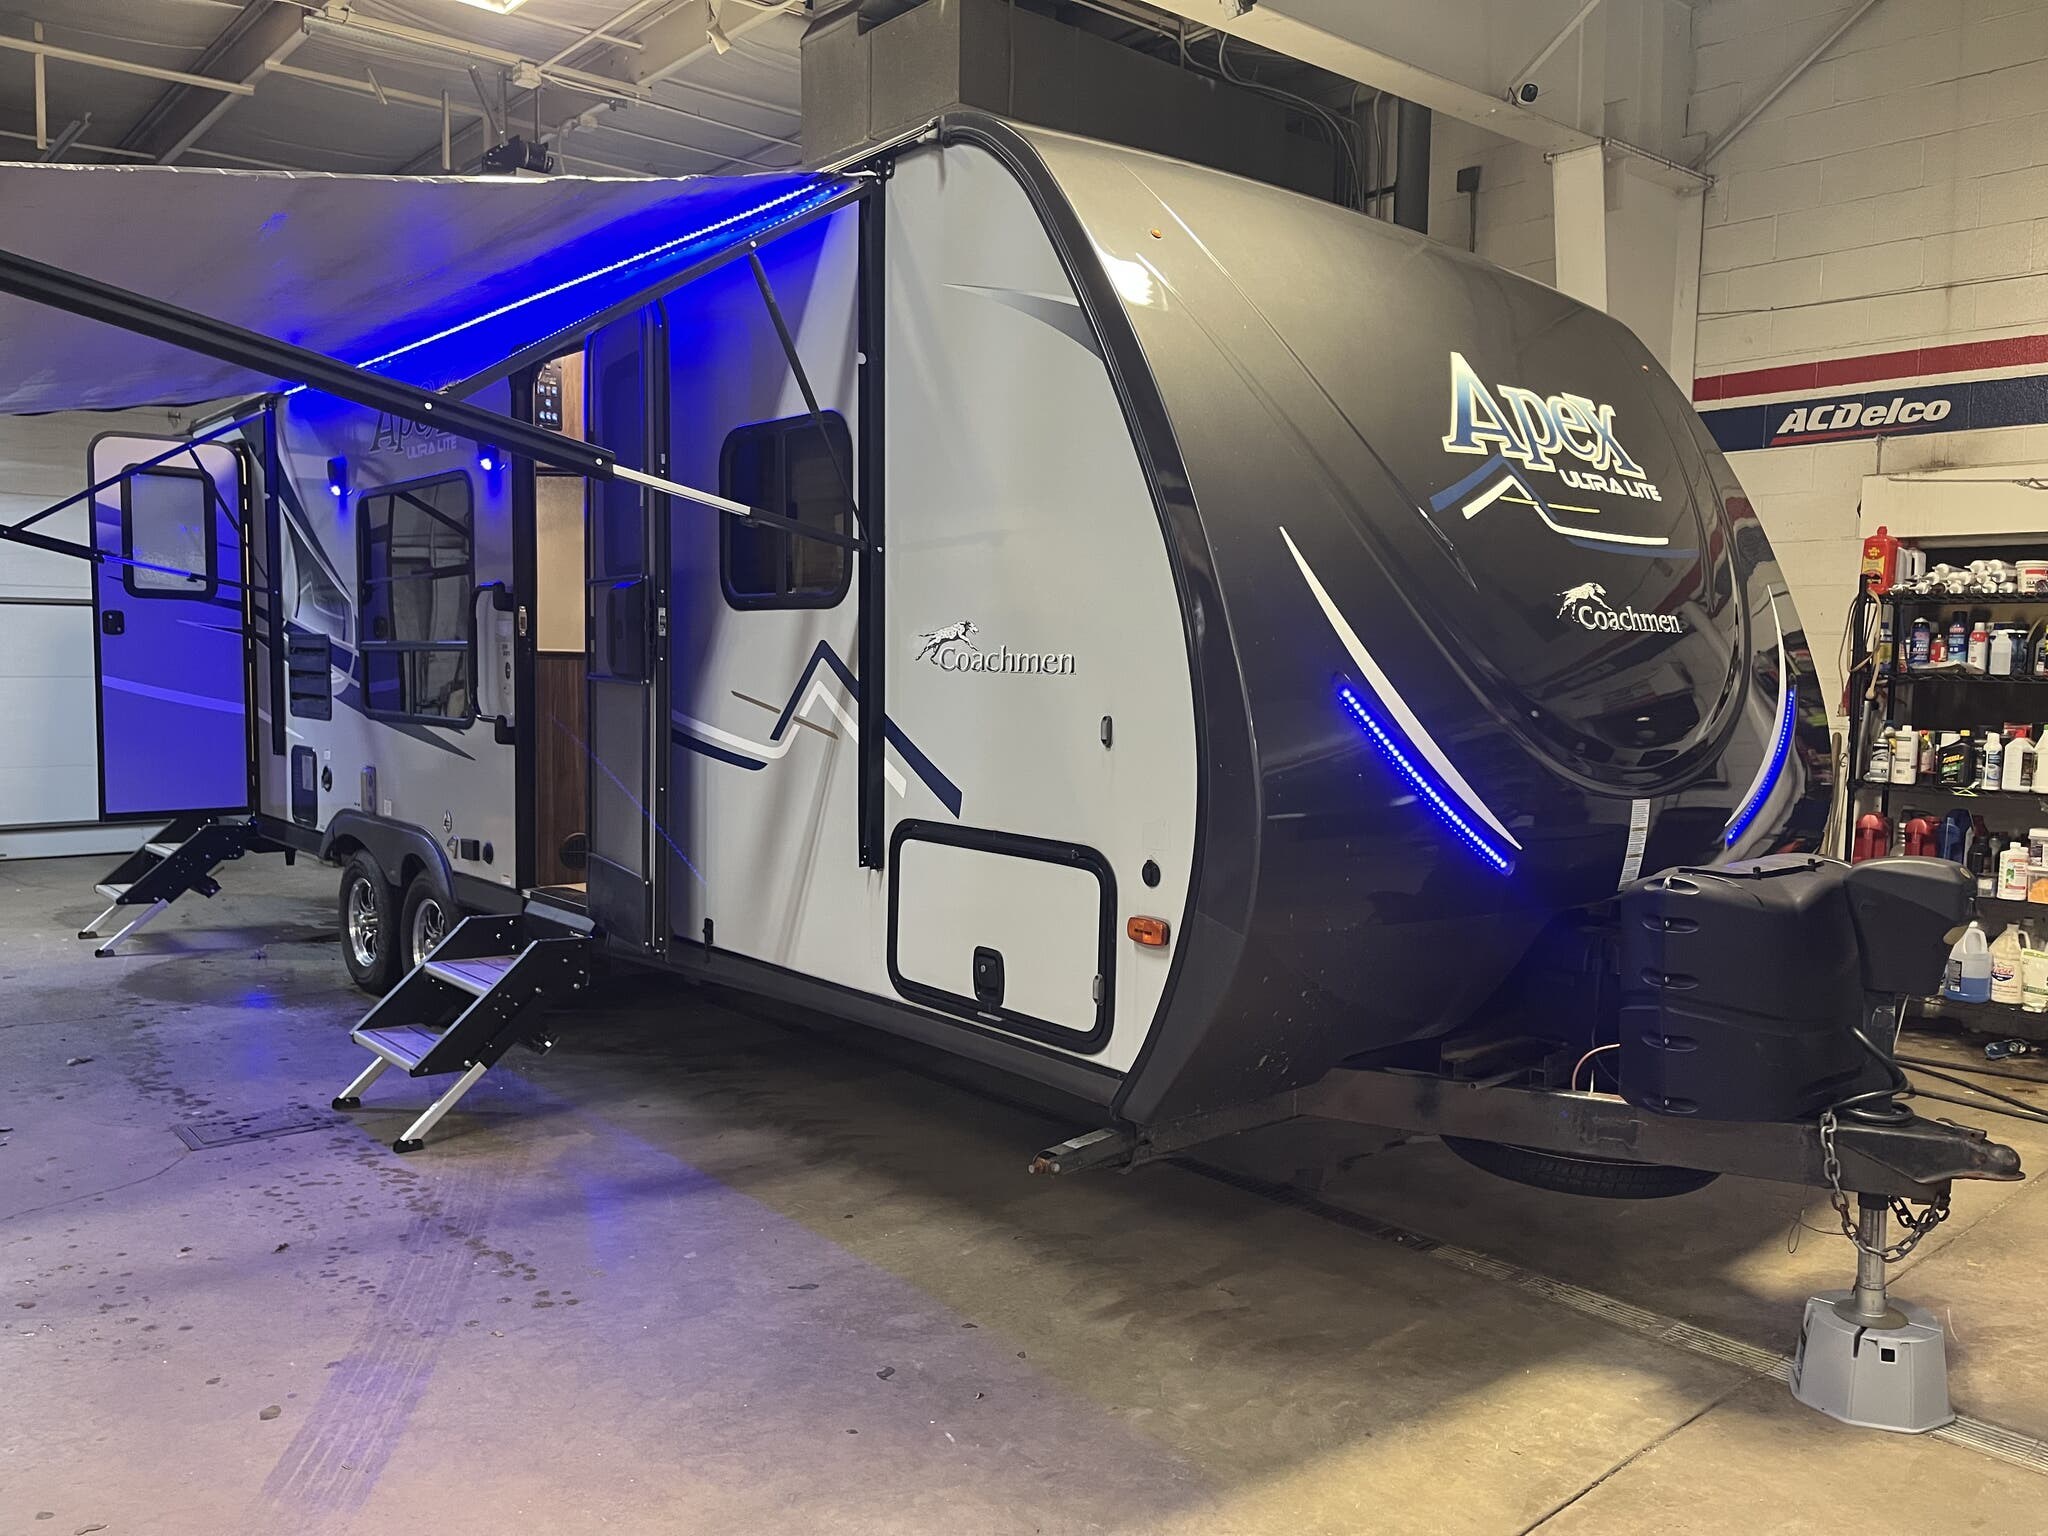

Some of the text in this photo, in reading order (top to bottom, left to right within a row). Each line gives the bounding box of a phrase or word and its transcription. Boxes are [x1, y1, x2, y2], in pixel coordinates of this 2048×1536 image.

[1442, 351, 1647, 480] Apex
[1776, 397, 1951, 434] ACDelco
[1558, 468, 1663, 502] ULTRA LITE
[1578, 605, 1683, 633] Coachmen
[937, 644, 1077, 676] Coachmen
